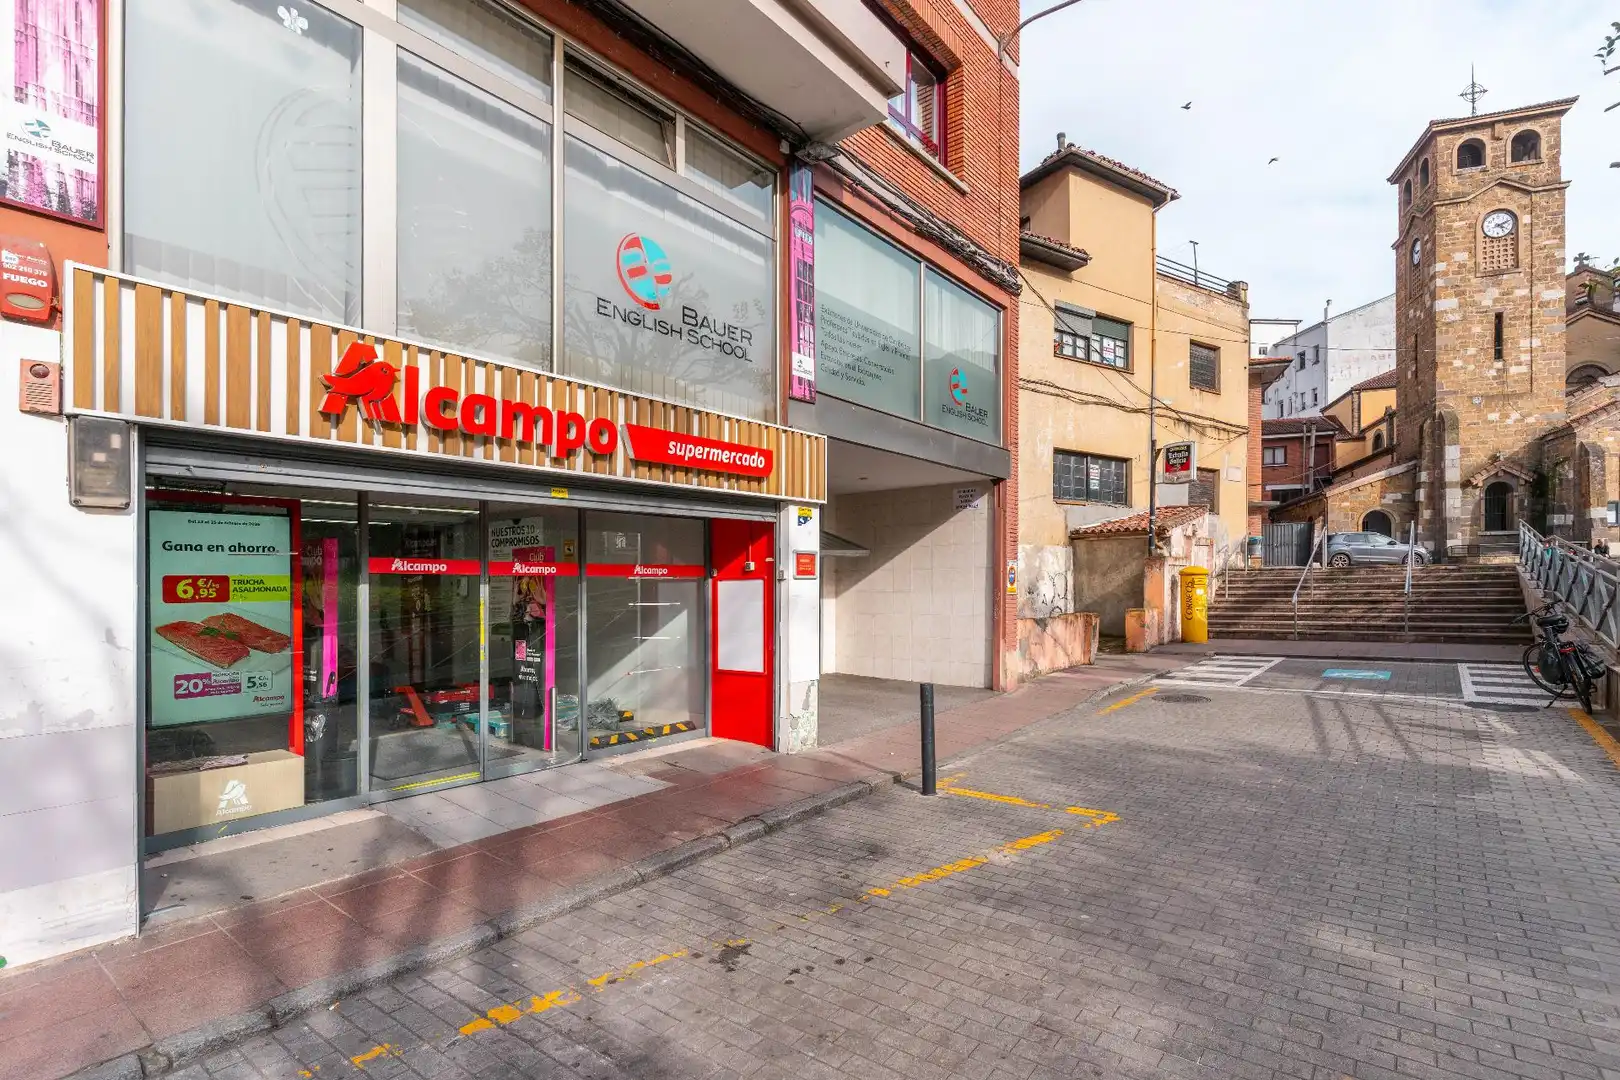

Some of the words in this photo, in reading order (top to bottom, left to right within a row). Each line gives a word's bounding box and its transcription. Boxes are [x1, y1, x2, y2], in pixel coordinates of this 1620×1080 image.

[6, 132, 52, 151] ENGLISH
[54, 148, 94, 164] SCHOOL
[52, 140, 94, 160] BAUER
[3, 272, 48, 288] FUEGO
[596, 296, 682, 340] ENGLISH
[687, 329, 752, 362] SCHOOL
[682, 305, 752, 346] BAUER
[318, 341, 618, 459] Alcampo
[966, 402, 988, 418] BAUER
[667, 438, 765, 469] supermercado
[492, 526, 526, 537] NUESTROS
[527, 525, 535, 535] 10
[162, 541, 203, 552] Gana
[207, 544, 224, 552] en
[391, 558, 447, 572] Alcampo
[529, 553, 545, 562] Club
[512, 562, 557, 575] Alcampo
[634, 565, 668, 575] Alcampo
[215, 805, 252, 816] Alcampo
